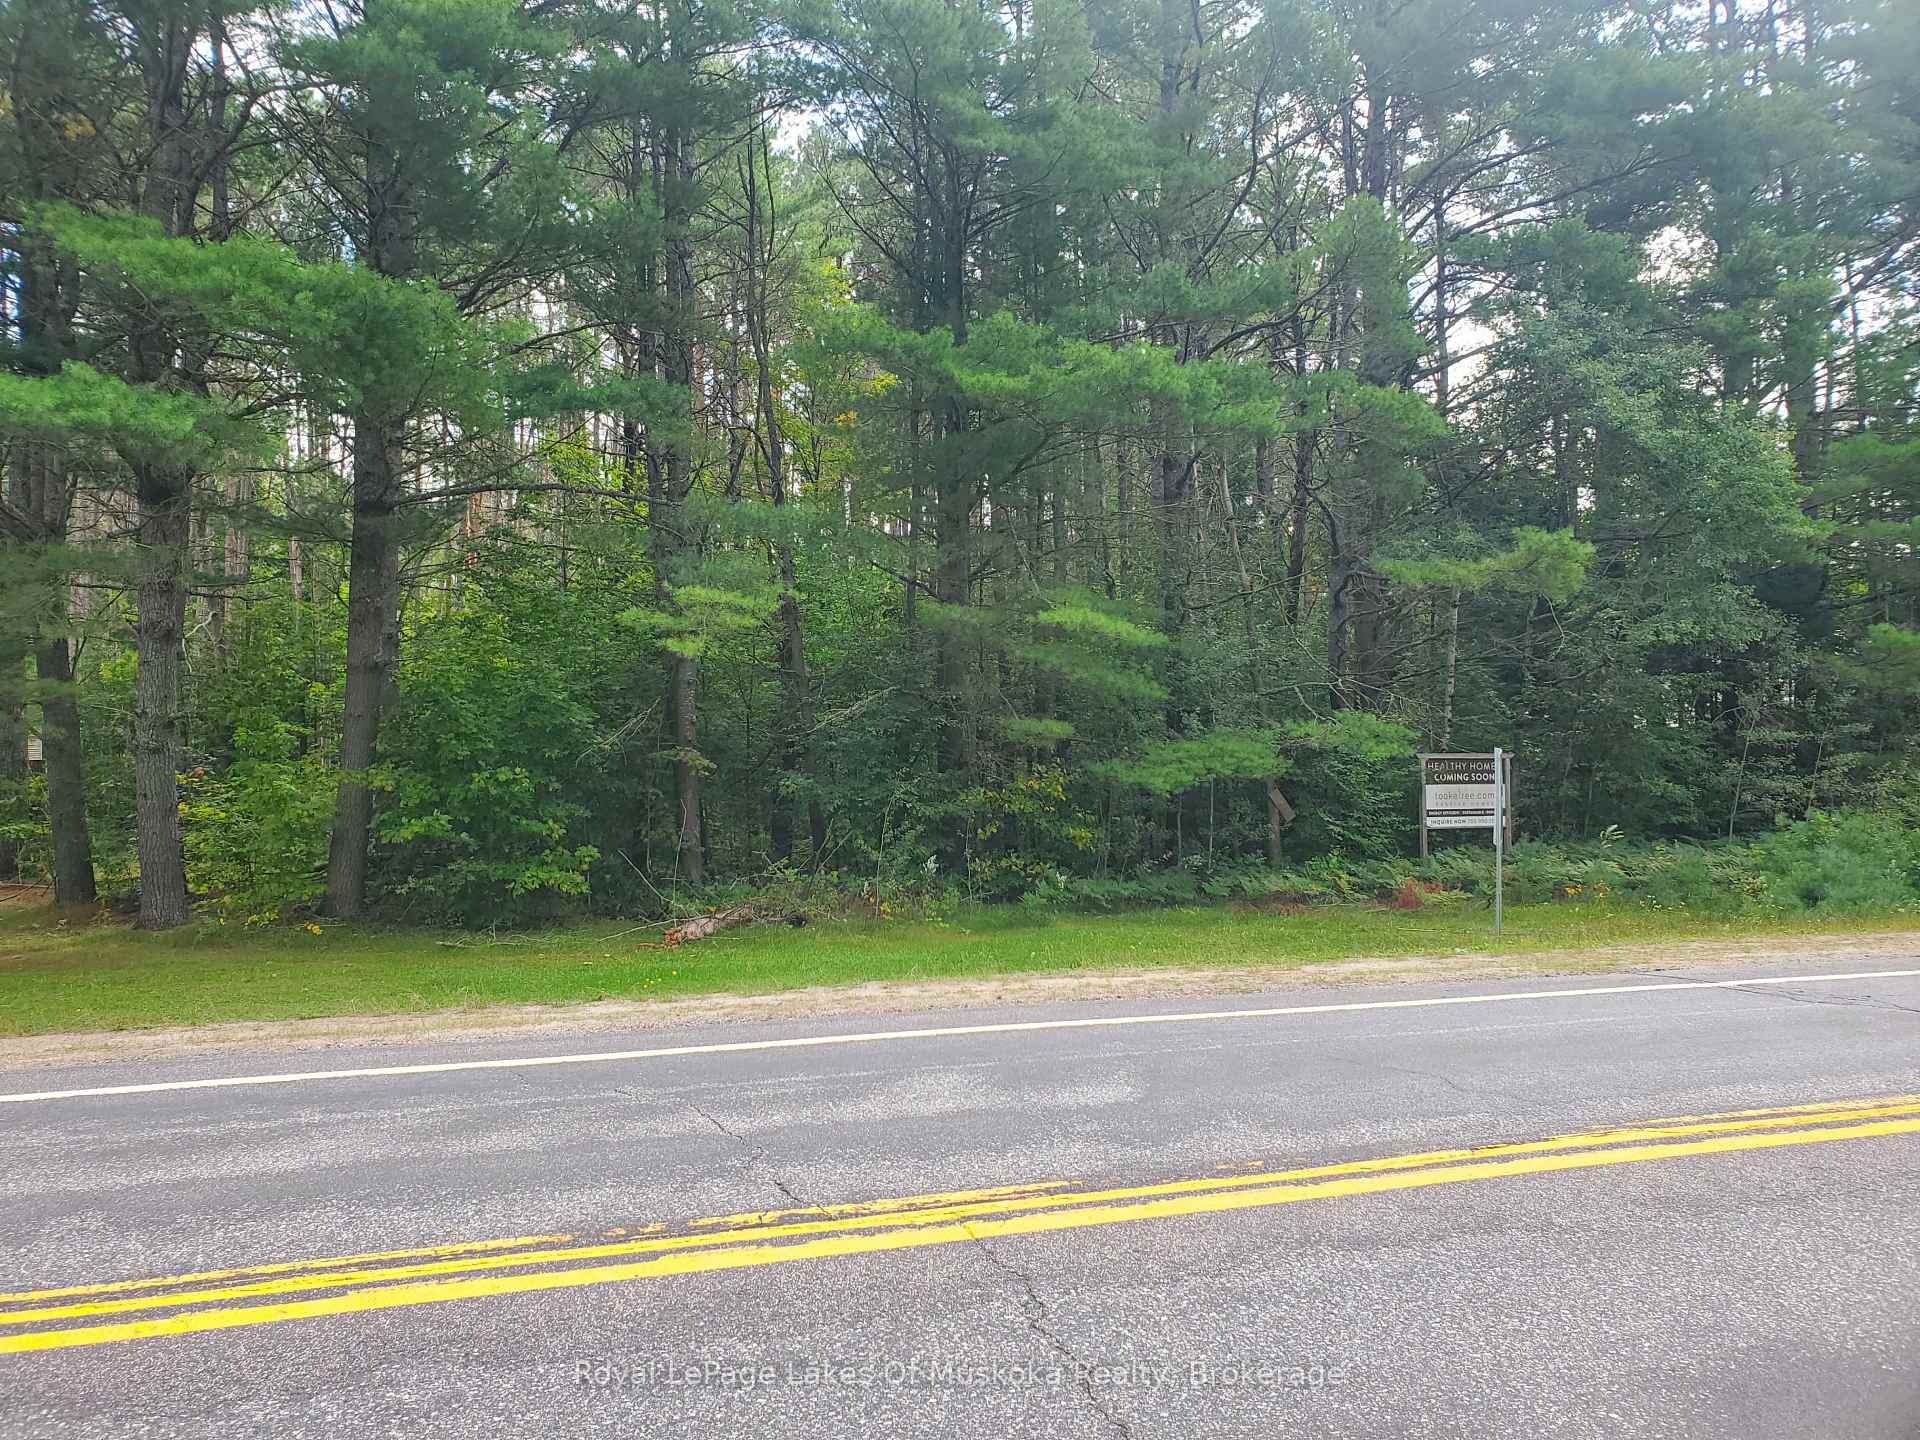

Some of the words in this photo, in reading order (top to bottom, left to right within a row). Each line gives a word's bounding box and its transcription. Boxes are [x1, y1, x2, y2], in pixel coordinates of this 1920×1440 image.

[1428, 762, 1468, 771] HEALTHY
[1470, 762, 1496, 771] HOME
[1434, 773, 1470, 782] COMING
[1471, 773, 1495, 781] SOON
